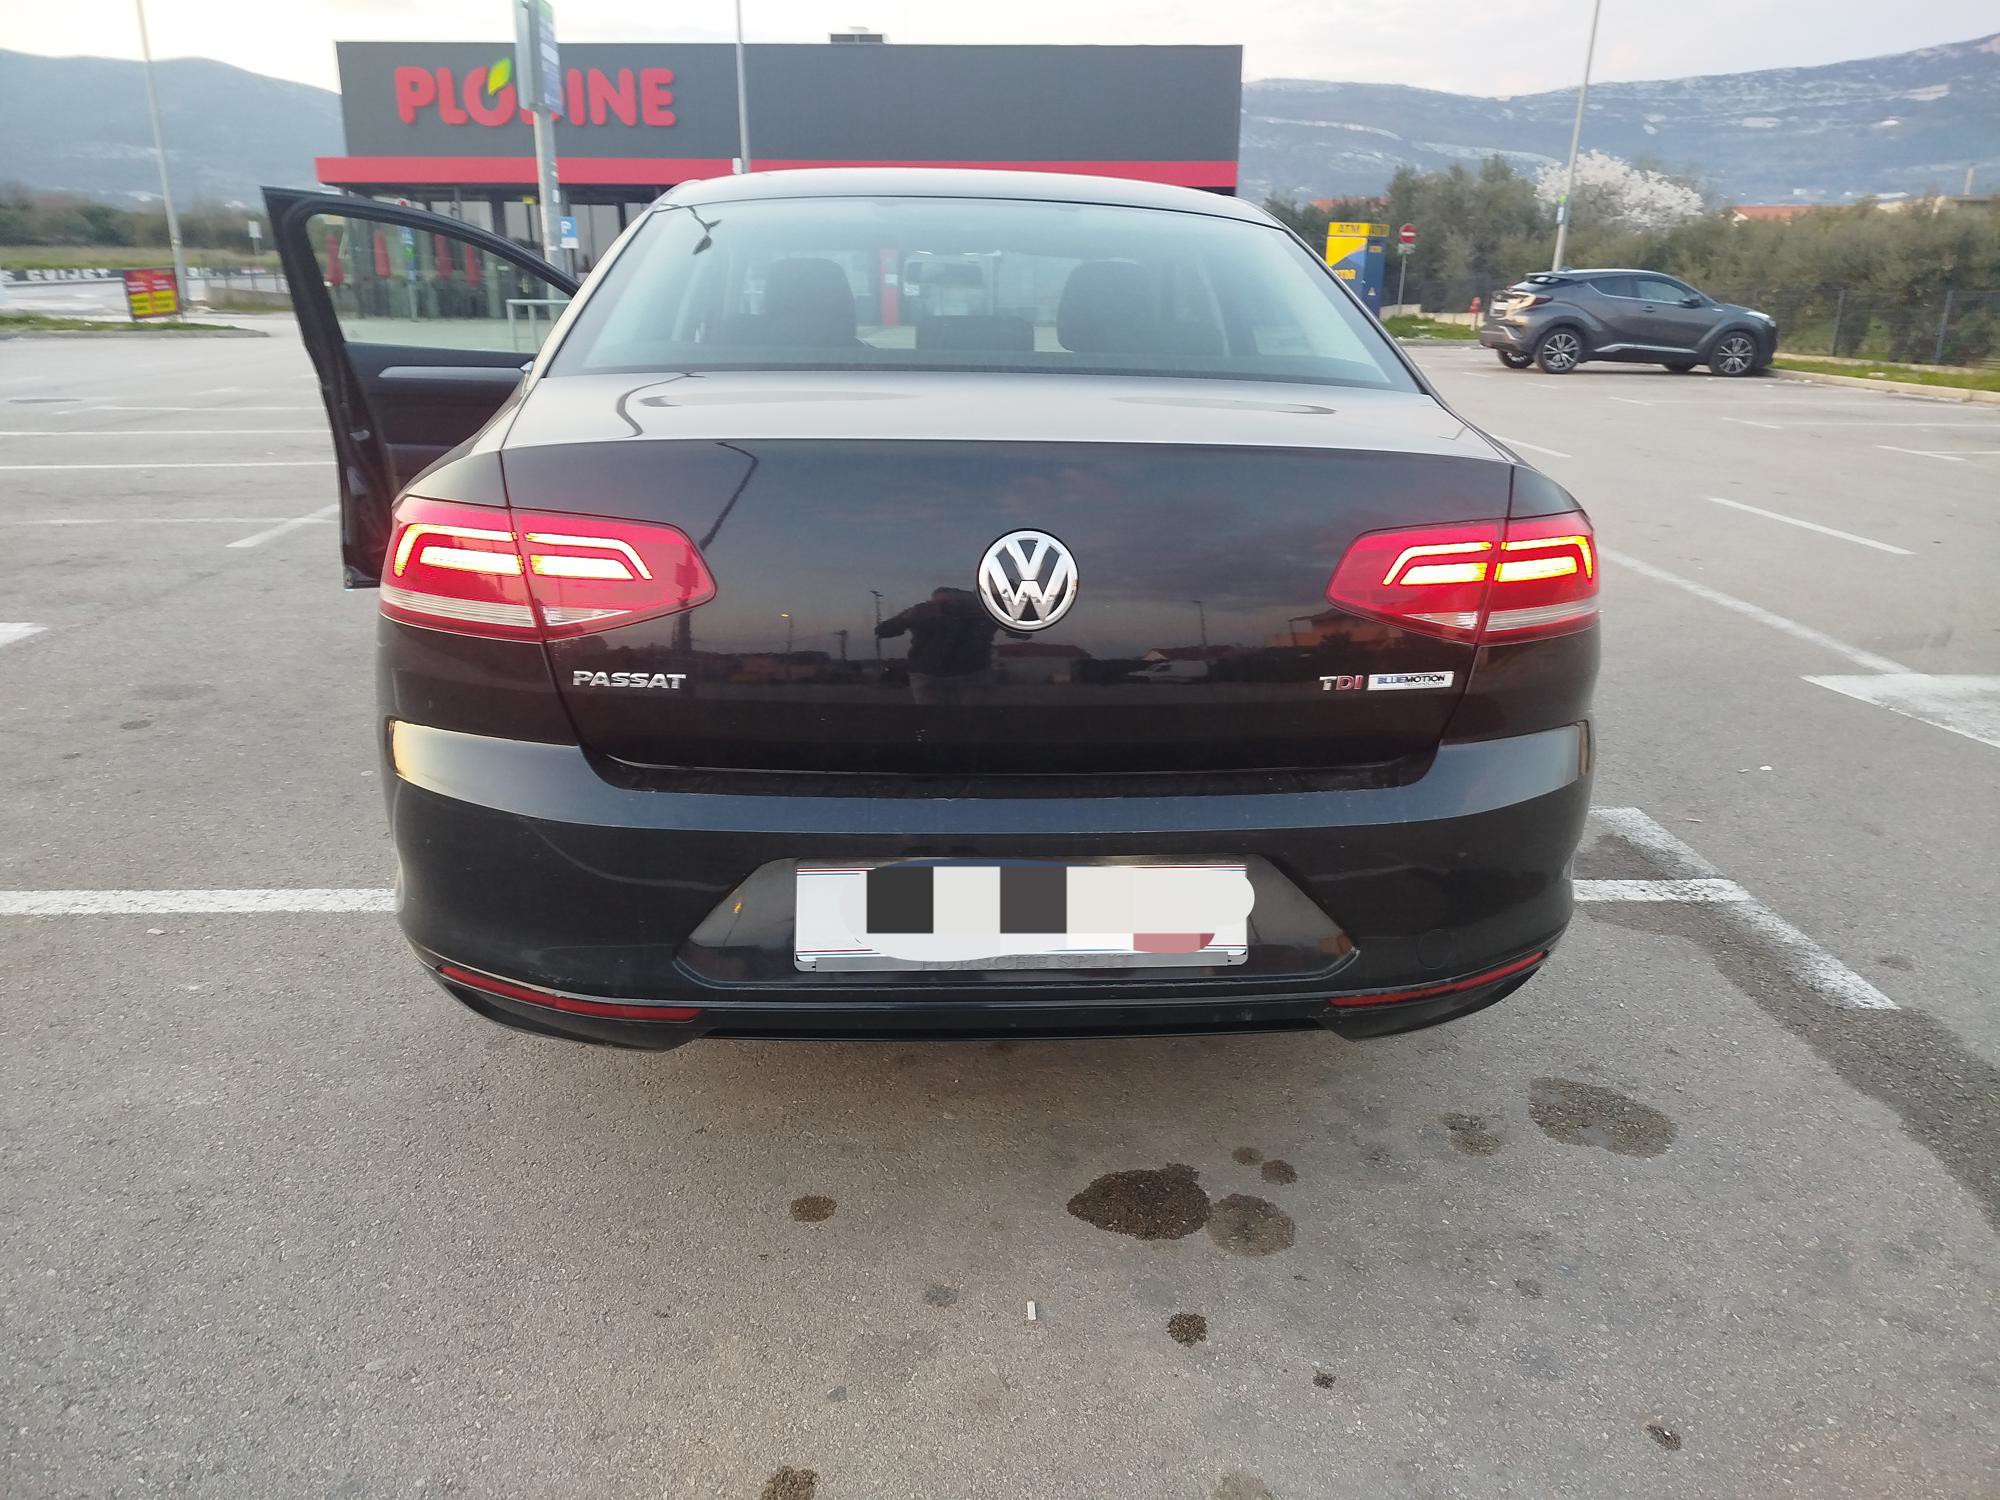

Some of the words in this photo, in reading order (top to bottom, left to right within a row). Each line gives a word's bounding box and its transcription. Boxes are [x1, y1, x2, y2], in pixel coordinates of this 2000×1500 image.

[394, 65, 677, 126] PLOINE
[983, 532, 1073, 627] VW
[572, 670, 687, 689] PASSAT
[1319, 675, 1364, 691] TDI
[1377, 674, 1446, 685] BLUEMOTION
